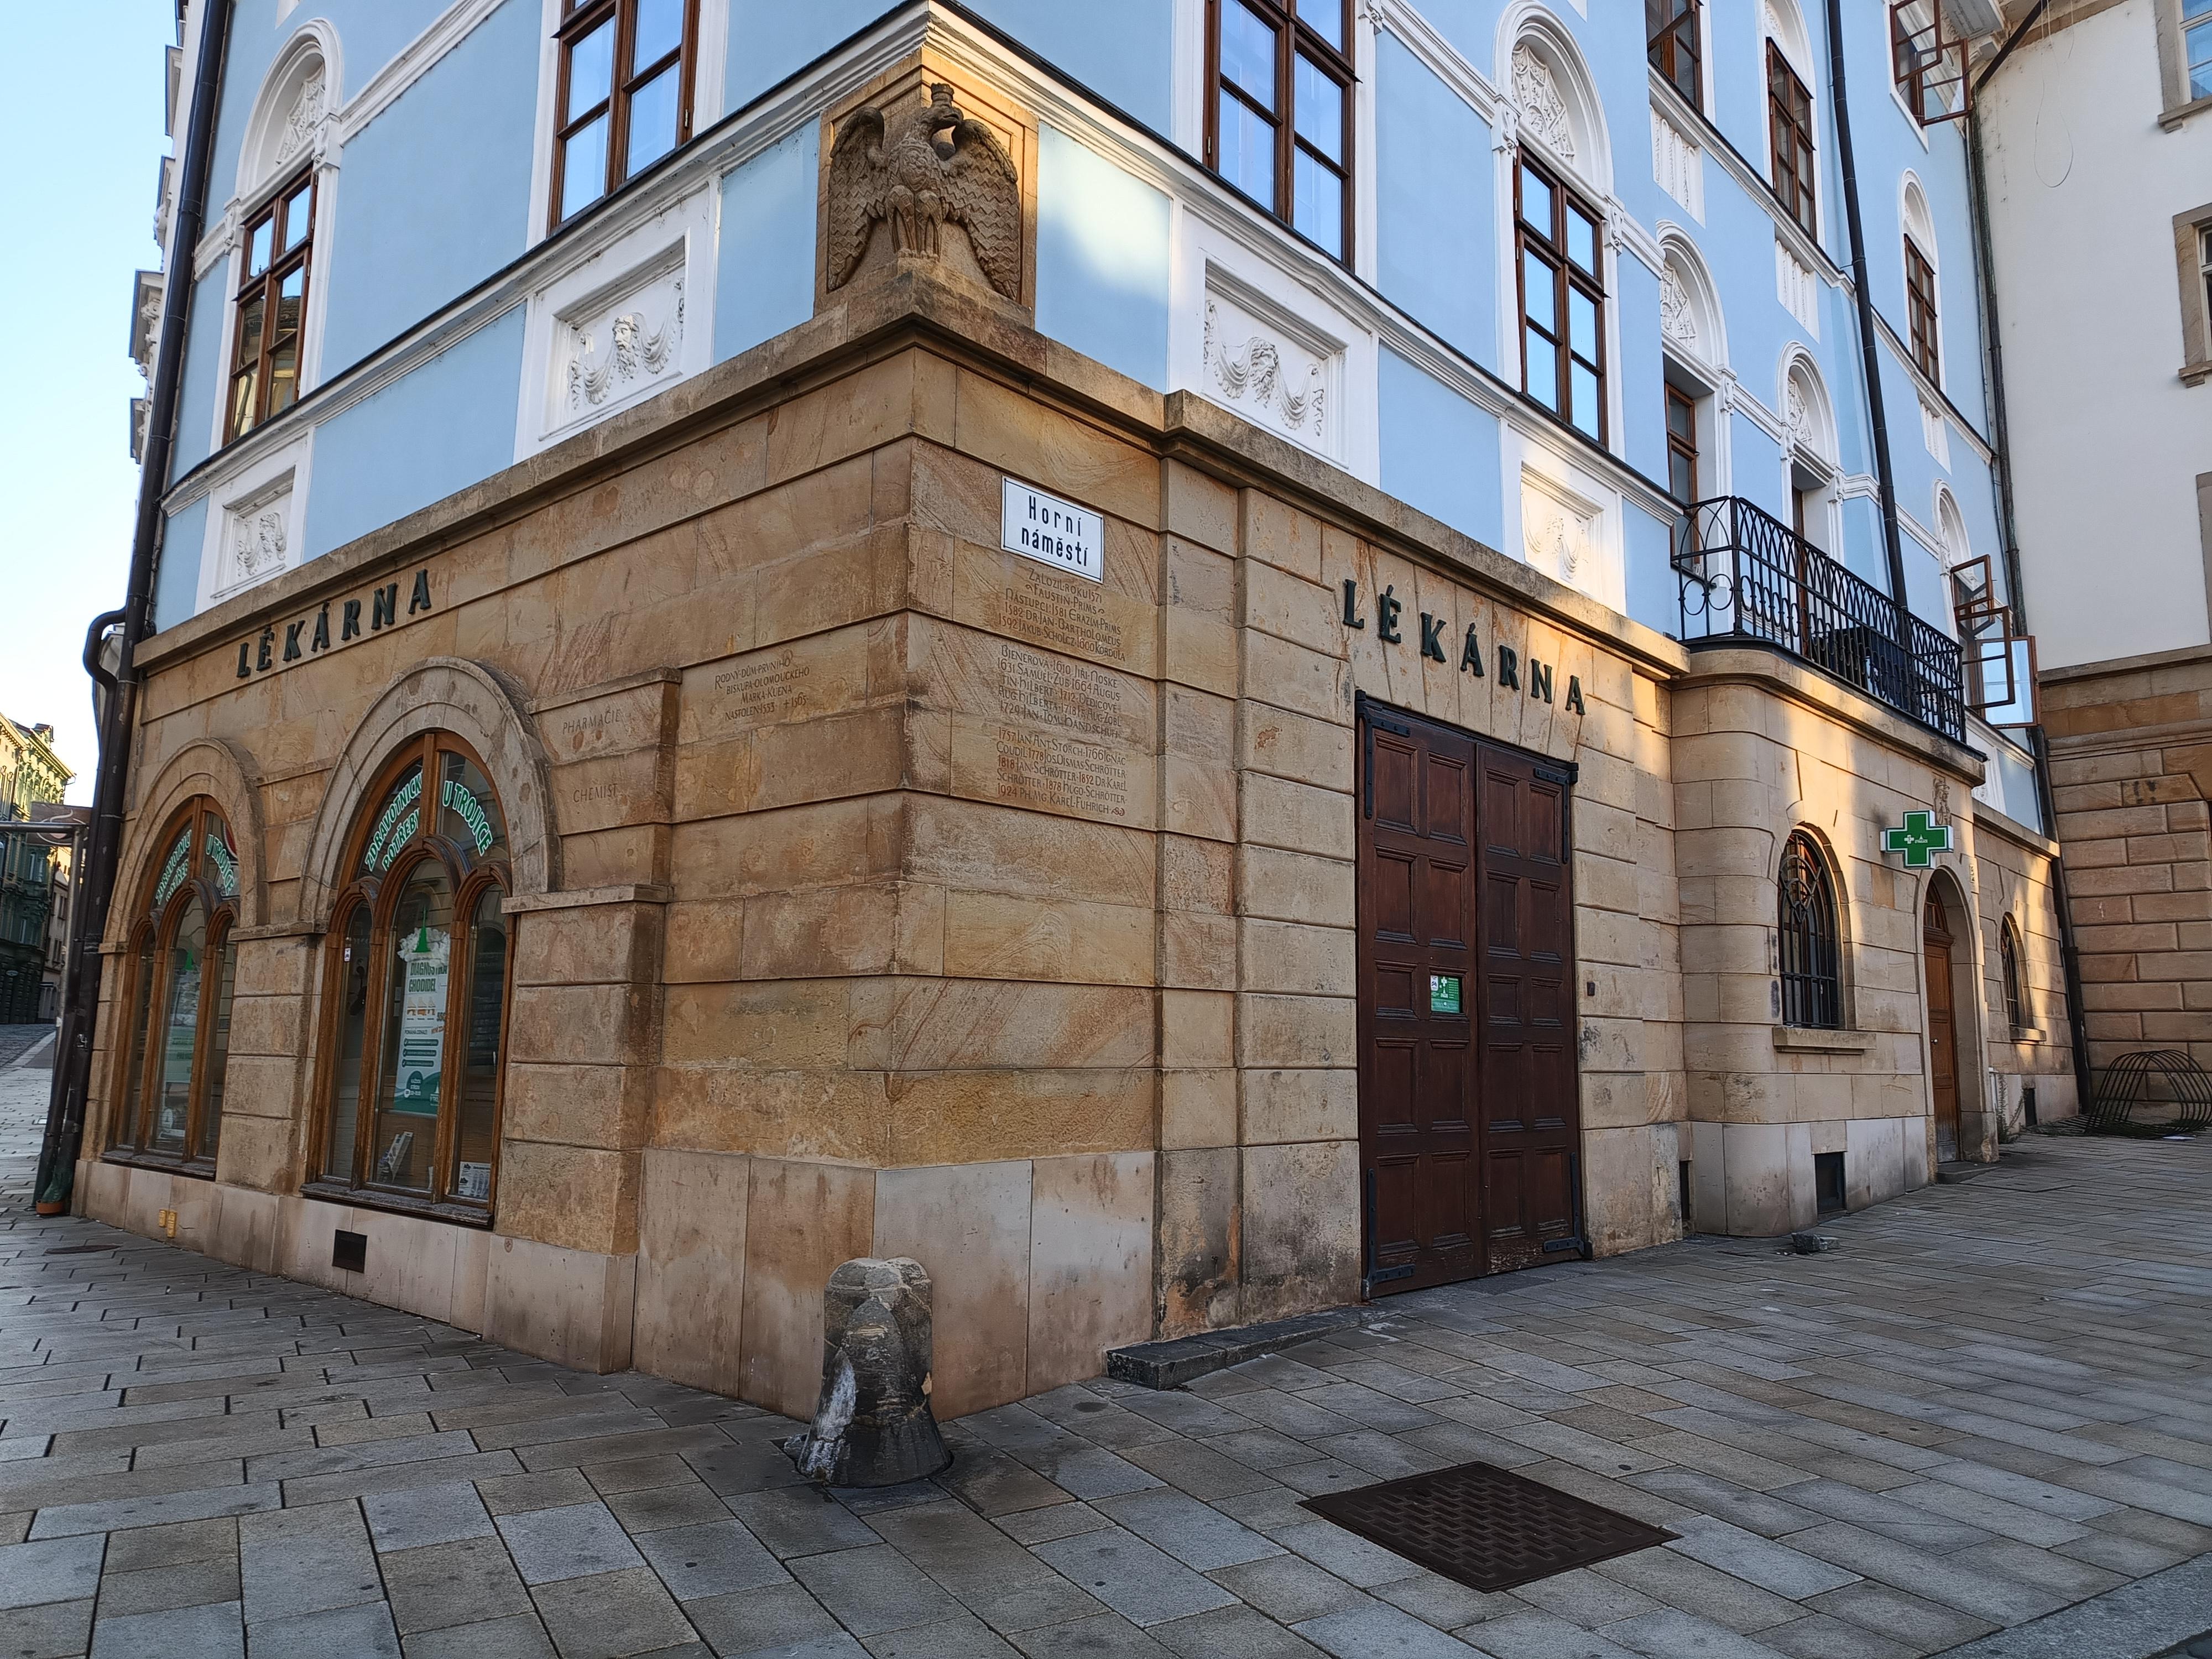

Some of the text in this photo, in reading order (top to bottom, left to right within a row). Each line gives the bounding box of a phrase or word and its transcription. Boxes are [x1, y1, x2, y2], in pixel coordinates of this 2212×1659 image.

[1029, 495, 1082, 537] Horní
[1021, 527, 1088, 566] náměstí
[236, 568, 432, 678] LÉKÁRNA
[1343, 578, 1586, 716] LÉKÁRNA
[364, 769, 423, 872] ZDRAVOTNICK
[442, 780, 493, 857] U TROJICE
[573, 783, 618, 803] CHEMIST
[206, 833, 214, 855] U
